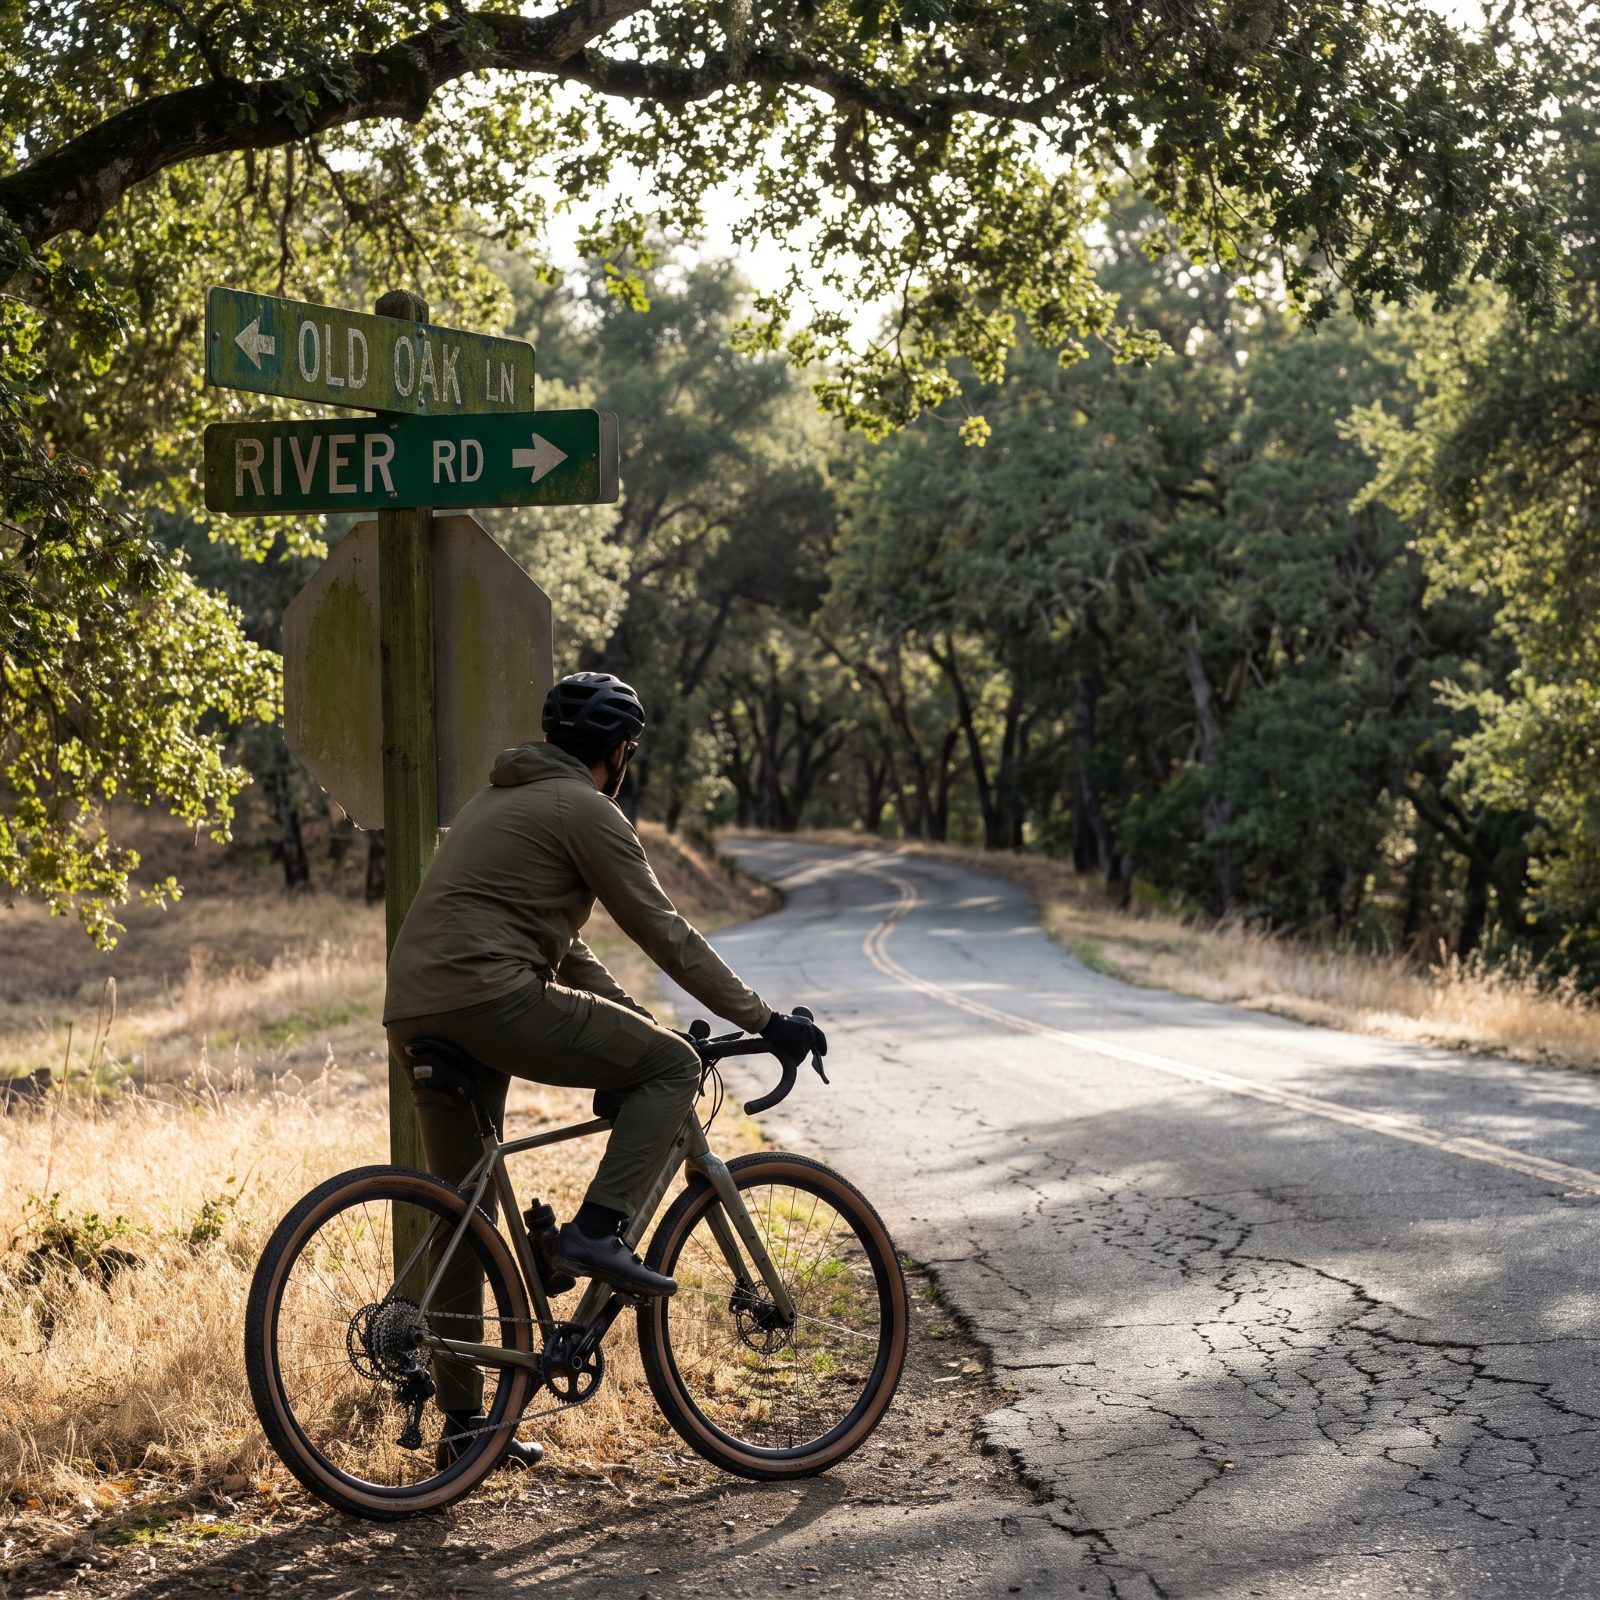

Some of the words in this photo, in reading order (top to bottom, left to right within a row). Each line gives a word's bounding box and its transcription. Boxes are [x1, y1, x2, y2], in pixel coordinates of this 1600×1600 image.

[298, 319, 369, 389] OLD
[393, 335, 461, 405] OAK
[485, 358, 515, 405] LN
[235, 433, 395, 497] RIVER
[432, 439, 484, 484] RD
